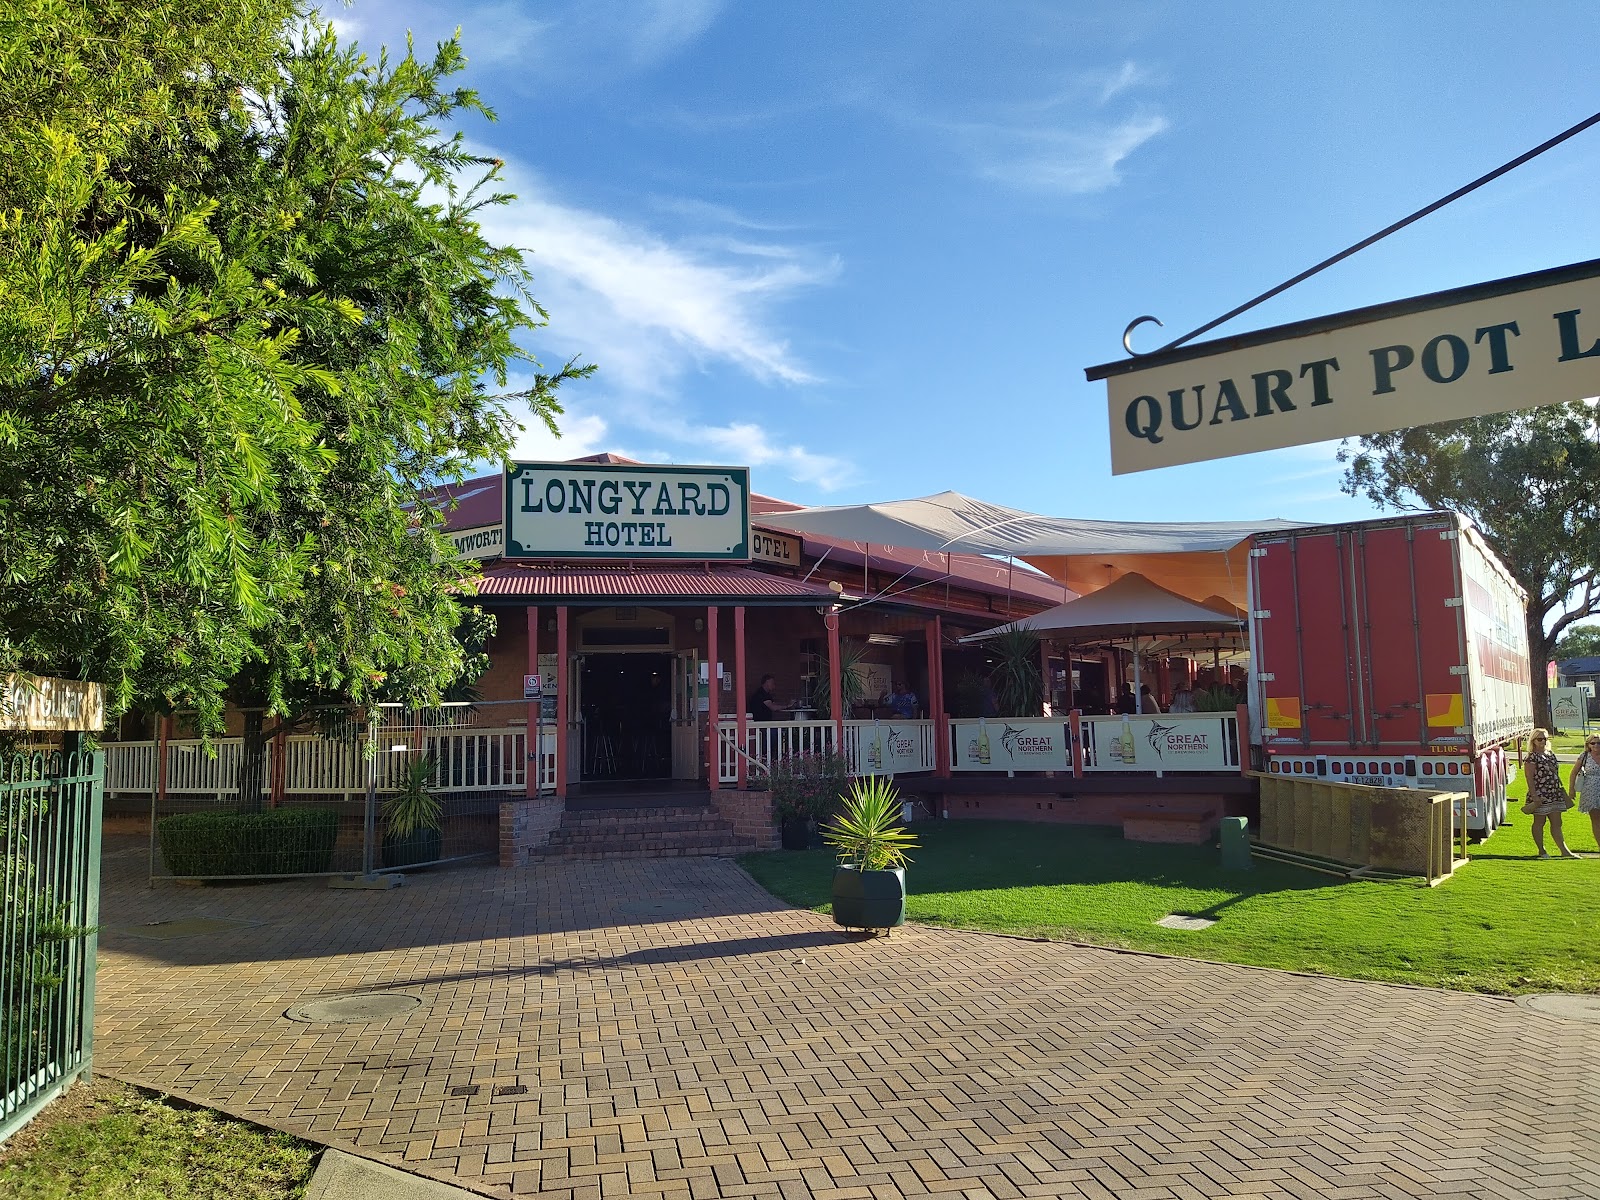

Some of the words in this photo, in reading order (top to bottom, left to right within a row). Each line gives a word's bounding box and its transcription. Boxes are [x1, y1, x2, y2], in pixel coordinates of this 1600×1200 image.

[1124, 357, 1341, 444] QUART
[1368, 320, 1521, 396] POT
[520, 478, 730, 516] LONGYARD
[584, 521, 672, 547] HOTEL
[753, 534, 790, 559] OTEL
[40, 680, 83, 718] Guitar
[896, 739, 914, 748] GREAT
[1017, 737, 1052, 746] GREAT
[1167, 734, 1208, 744] GREAT
[1429, 745, 1458, 753] TL105
